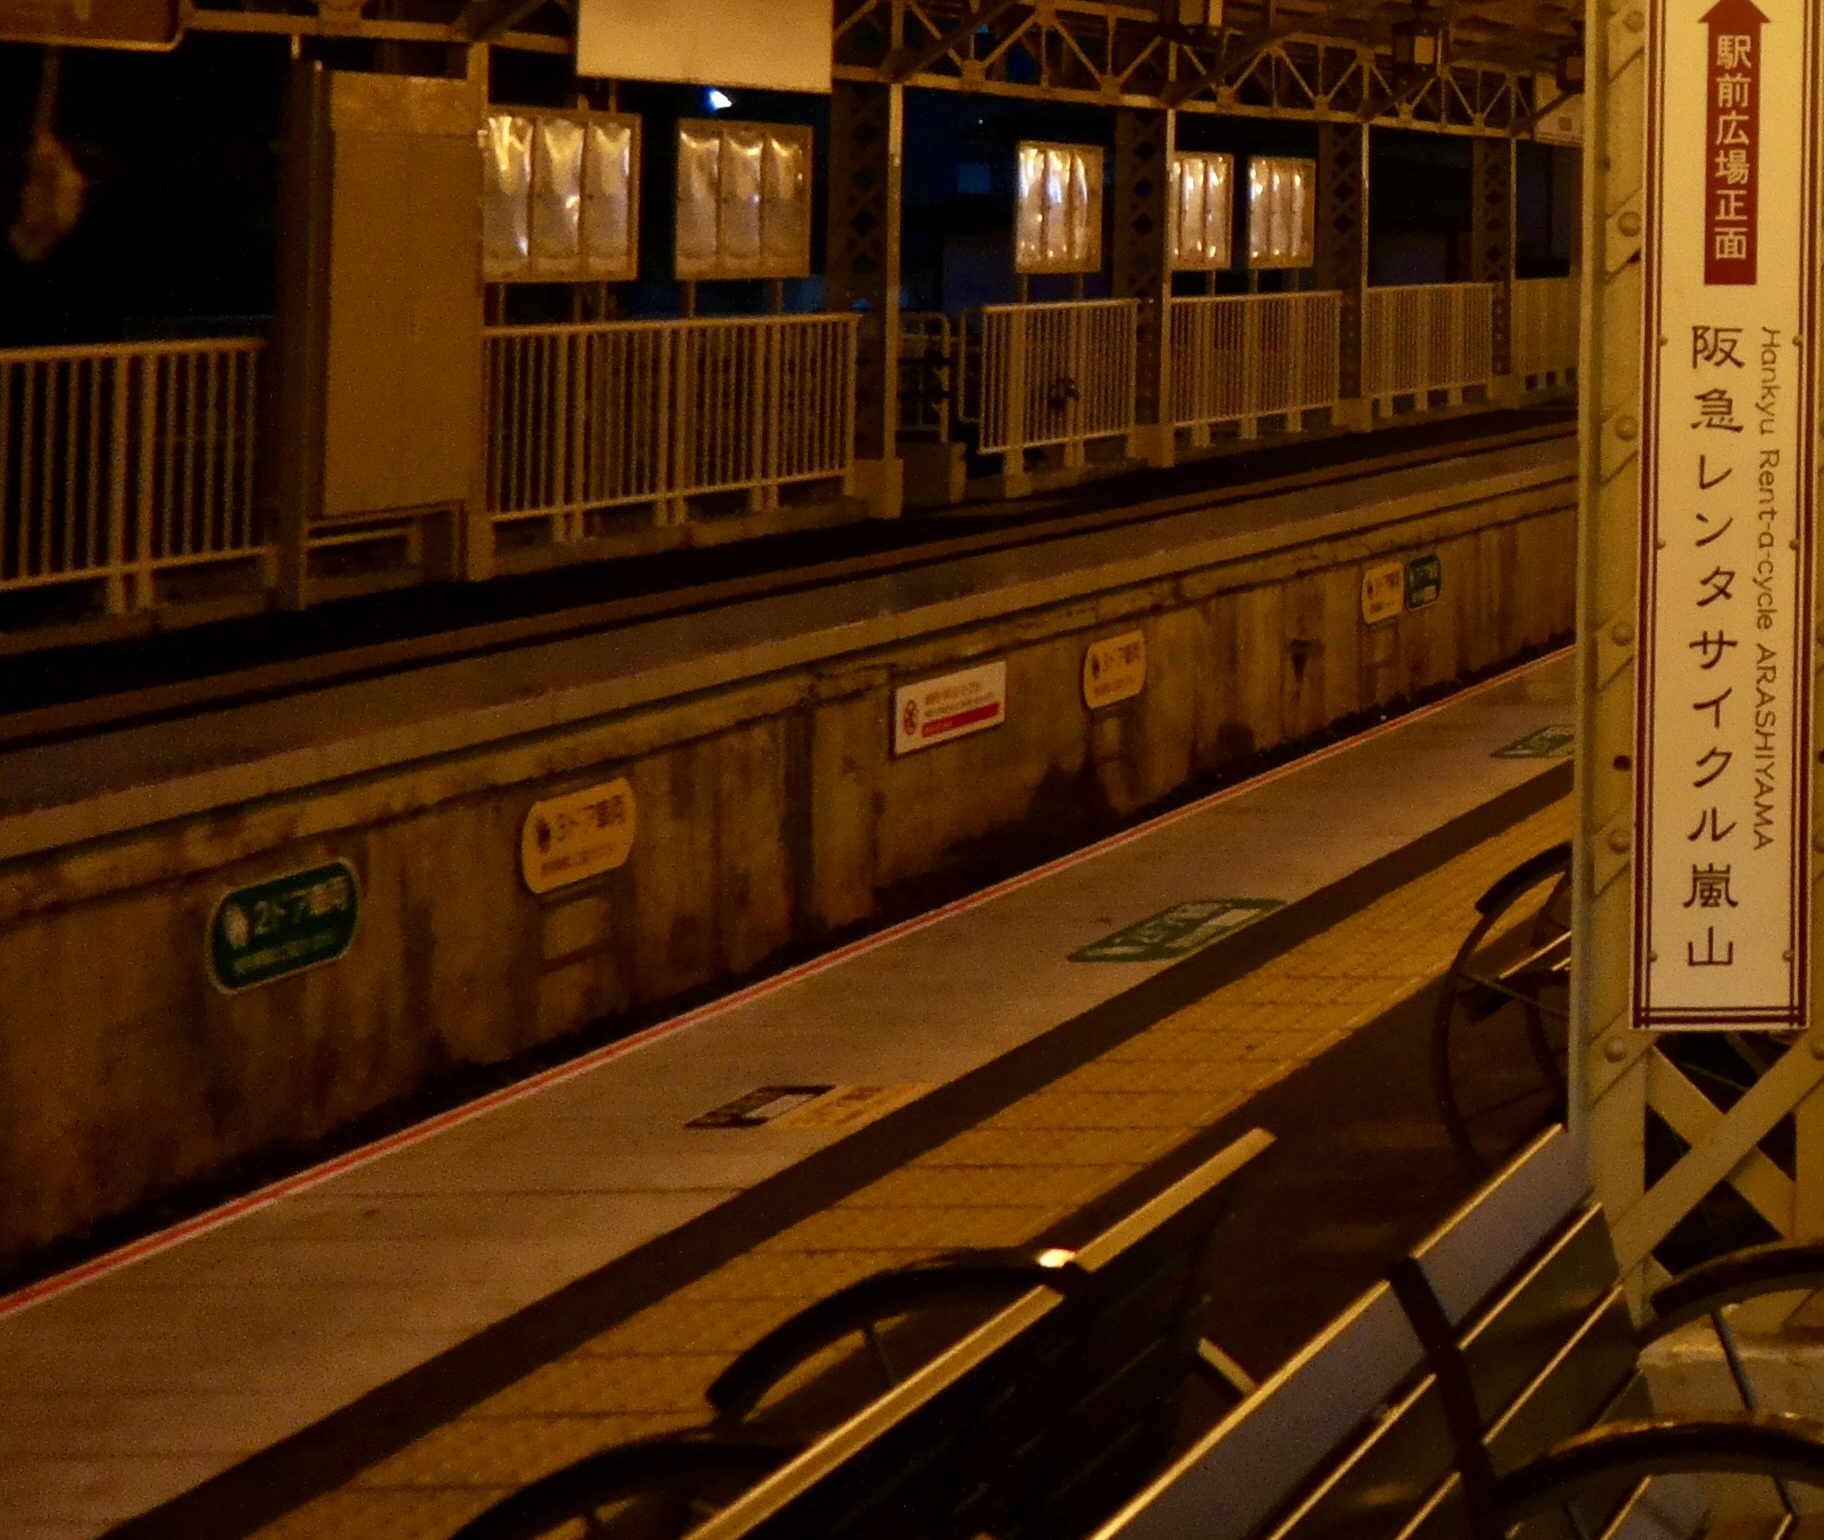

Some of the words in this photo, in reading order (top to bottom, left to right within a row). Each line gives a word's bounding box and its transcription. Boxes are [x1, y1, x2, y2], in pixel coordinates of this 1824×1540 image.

[1713, 33, 1752, 261] 駅前広場正面
[1755, 326, 1783, 434] Hankyu
[1752, 448, 1781, 630] Rent-a-cycle
[1683, 325, 1745, 967] 阪急レンタサイクル嵐山
[1752, 642, 1779, 851] ARASHIYAMA
